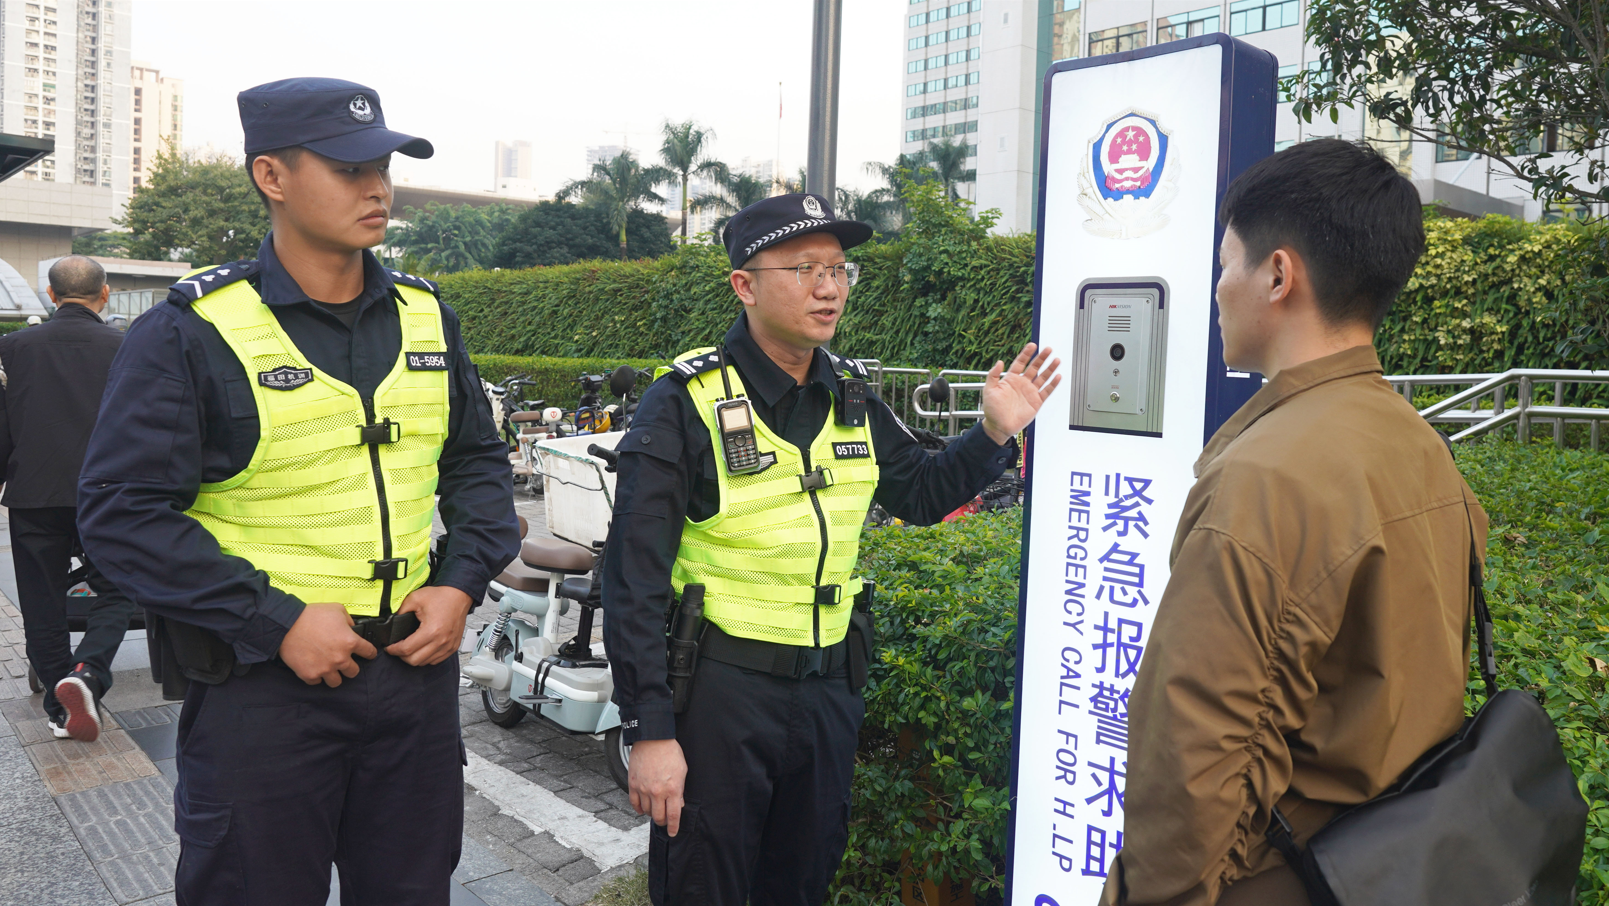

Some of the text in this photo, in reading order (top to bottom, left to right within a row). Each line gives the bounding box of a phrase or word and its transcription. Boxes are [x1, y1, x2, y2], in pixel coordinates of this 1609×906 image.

[410, 355, 446, 367] 01-5954
[836, 444, 868, 456] 057733
[1051, 470, 1093, 873] EMERGENCY CALL FOR HLP
